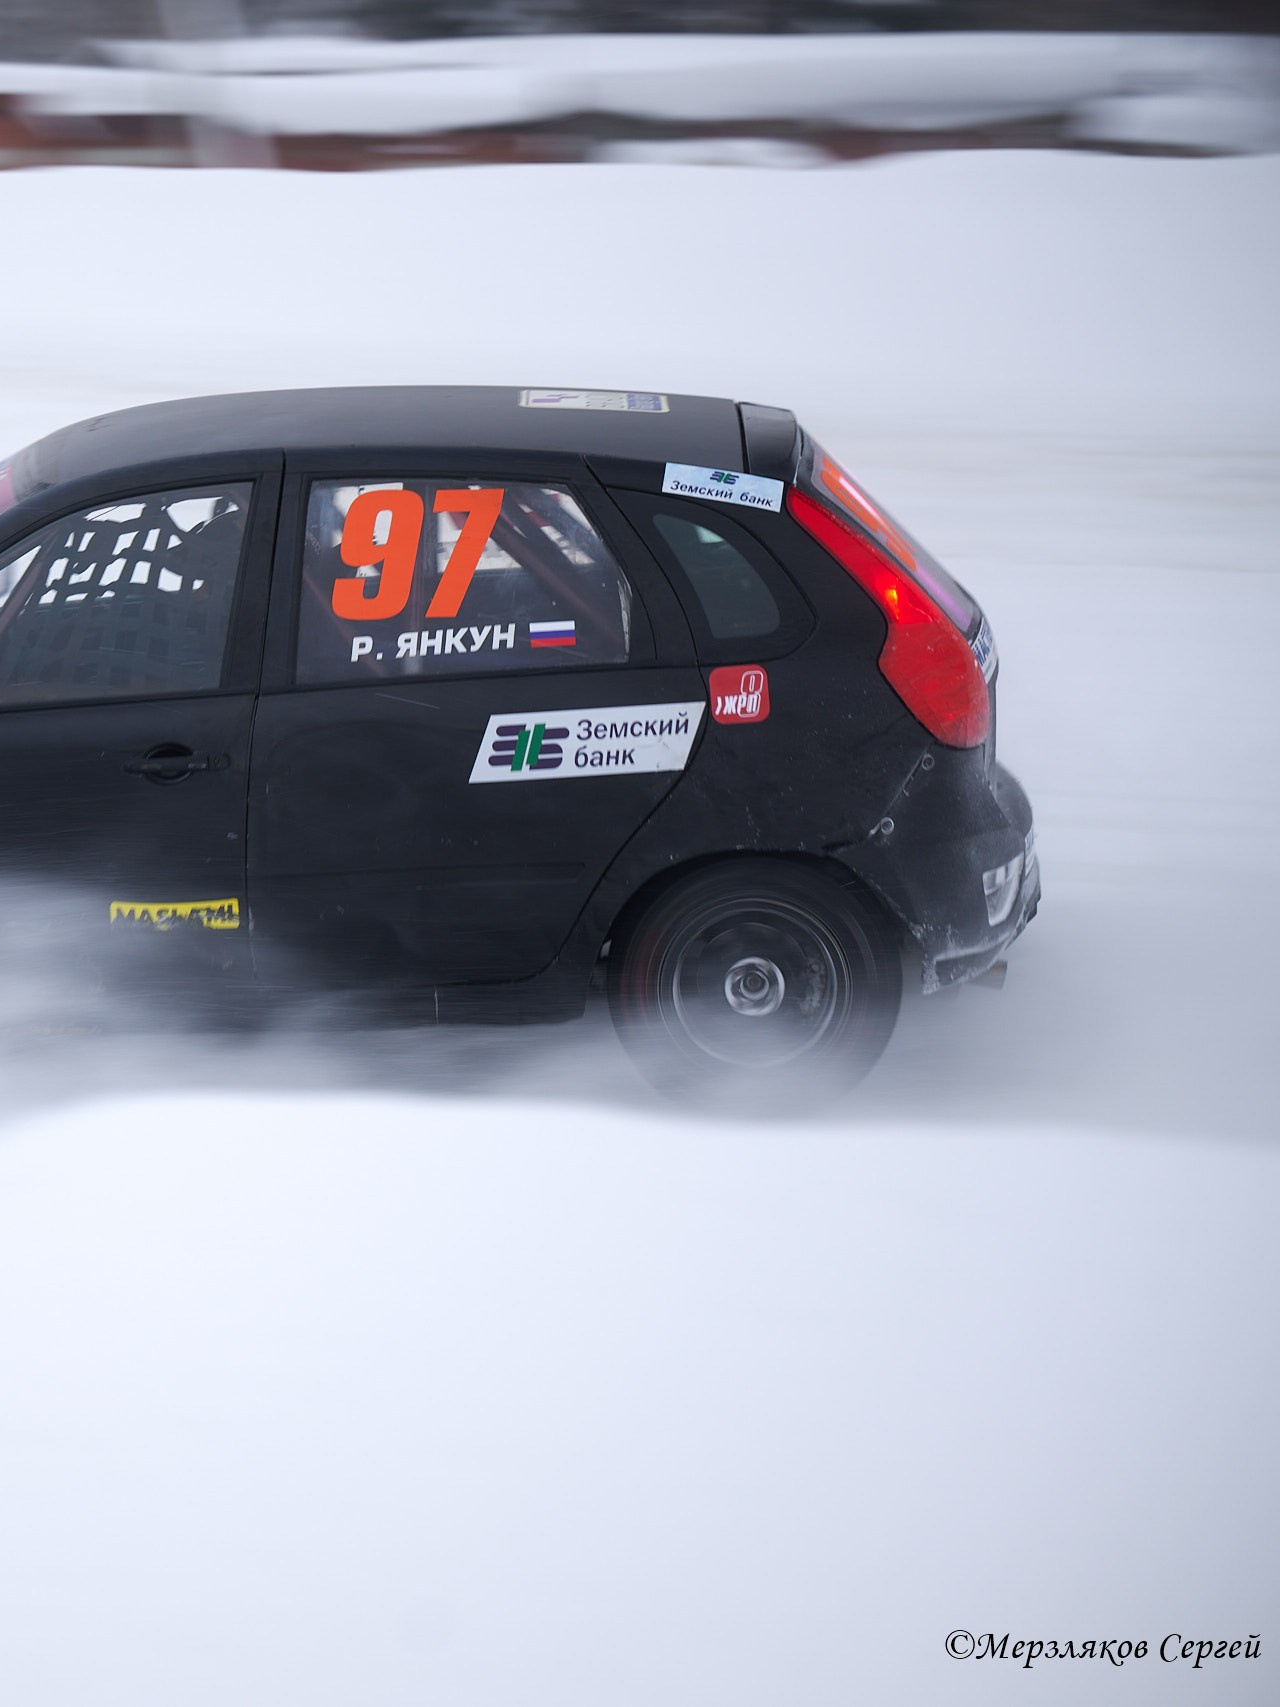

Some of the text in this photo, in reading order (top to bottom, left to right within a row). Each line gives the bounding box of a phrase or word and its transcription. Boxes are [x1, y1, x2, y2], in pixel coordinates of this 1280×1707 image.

[670, 480, 774, 508] Земский банк
[331, 487, 505, 621] 97
[395, 623, 517, 659] ЯНКУН
[576, 711, 689, 741] Земский
[574, 748, 636, 768] банк
